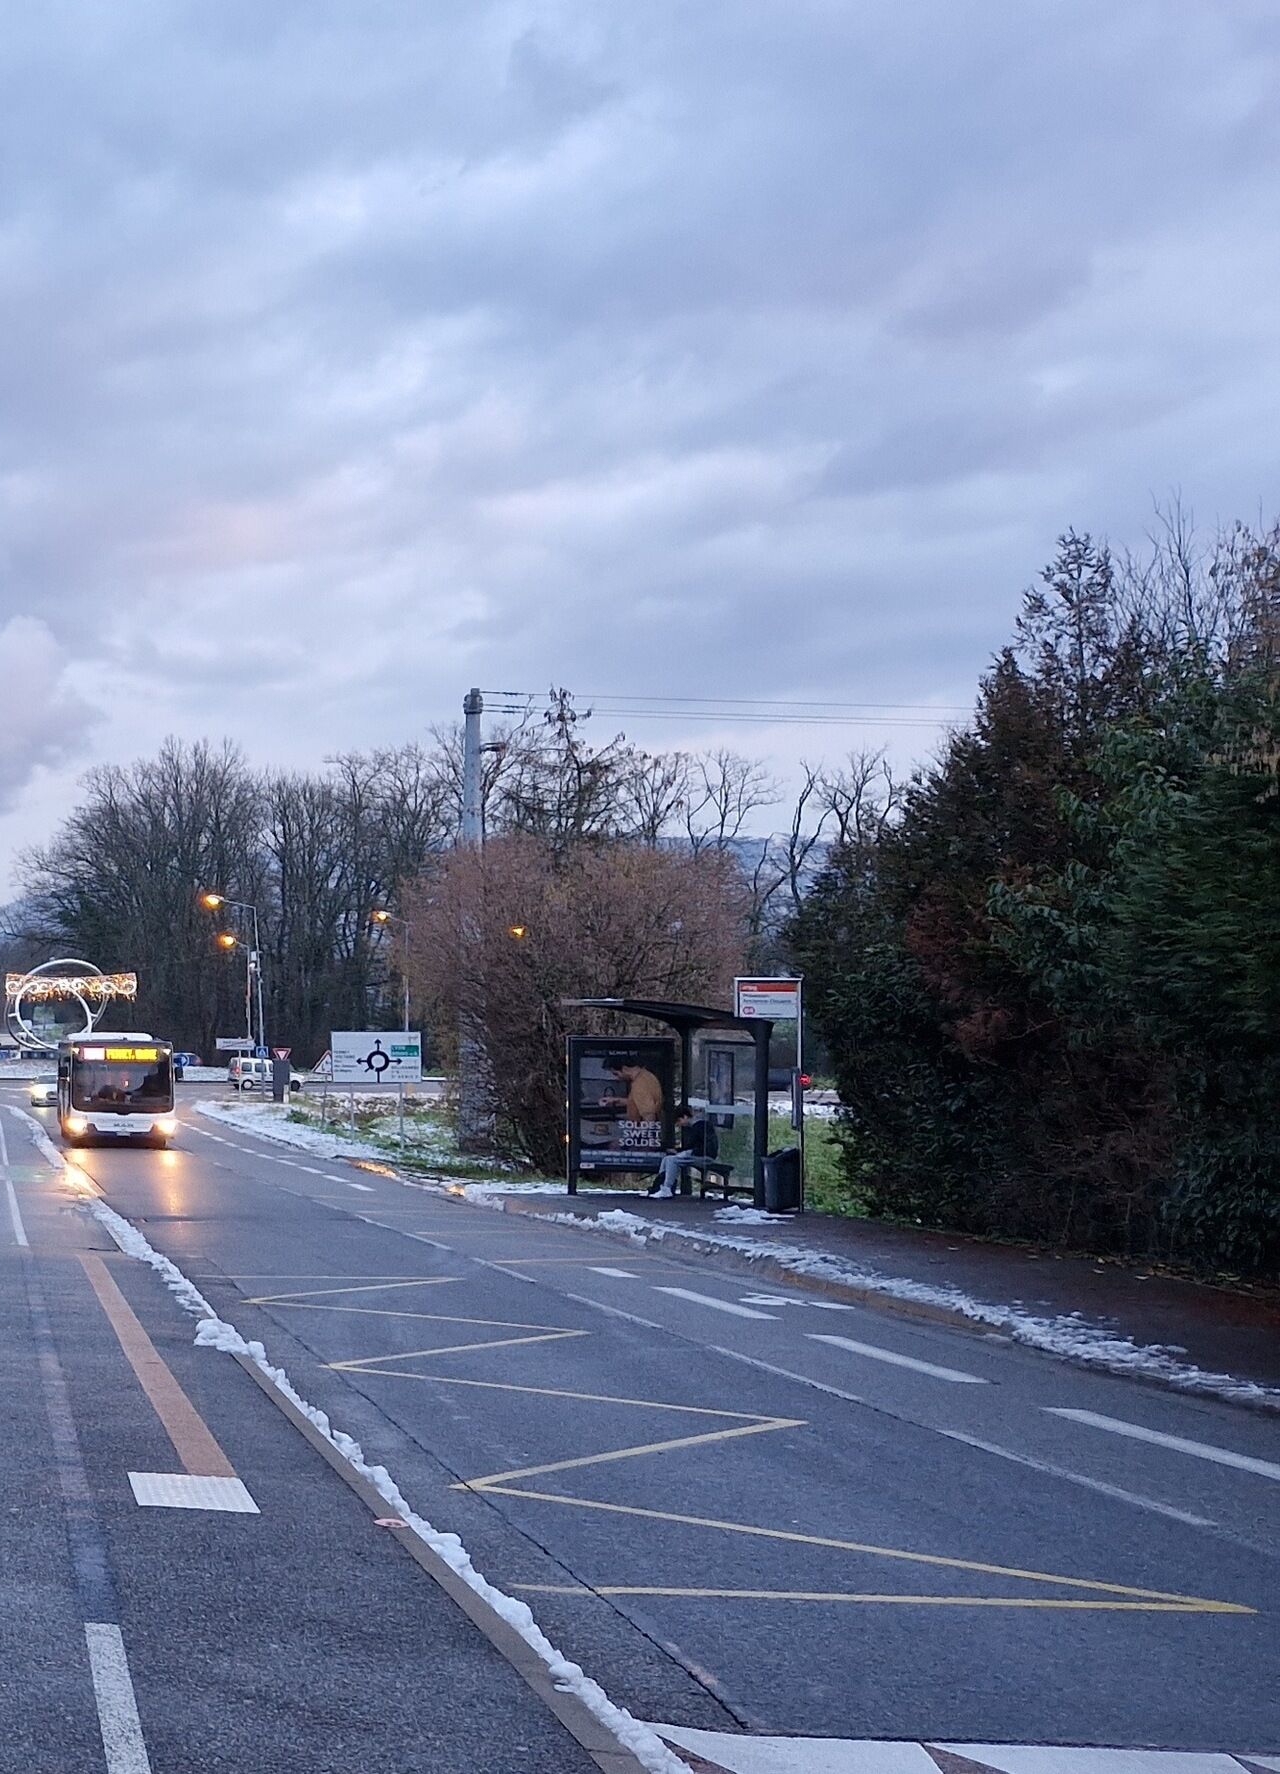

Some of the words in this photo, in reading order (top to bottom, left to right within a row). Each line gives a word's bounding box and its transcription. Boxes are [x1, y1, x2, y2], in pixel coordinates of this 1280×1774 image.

[618, 1120, 661, 1129] SOLDES
[623, 1129, 661, 1138] SWEET
[618, 1138, 661, 1147] SOLDES
